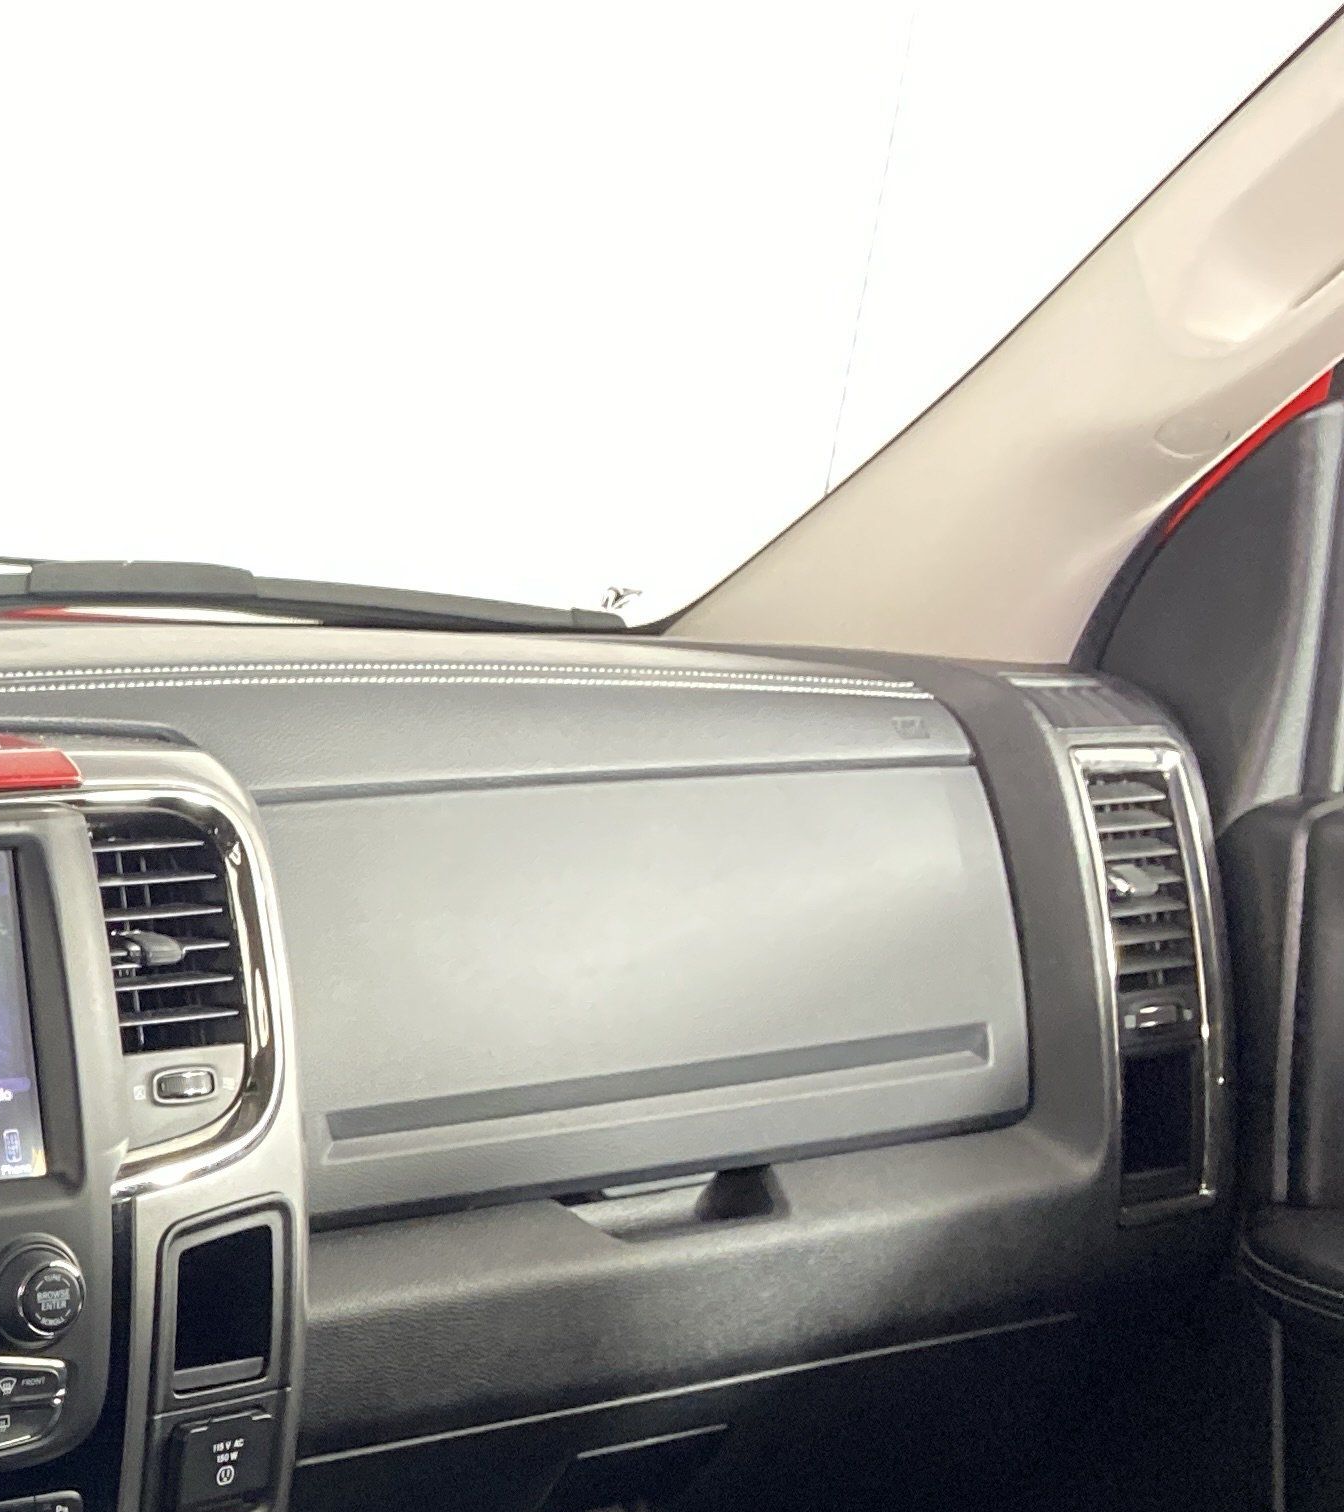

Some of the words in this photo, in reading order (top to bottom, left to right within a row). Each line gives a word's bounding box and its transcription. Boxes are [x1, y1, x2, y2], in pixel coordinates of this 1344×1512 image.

[36, 1288, 71, 1303] BROWSE
[41, 1301, 67, 1312] ENTER
[21, 1376, 46, 1387] FRONT
